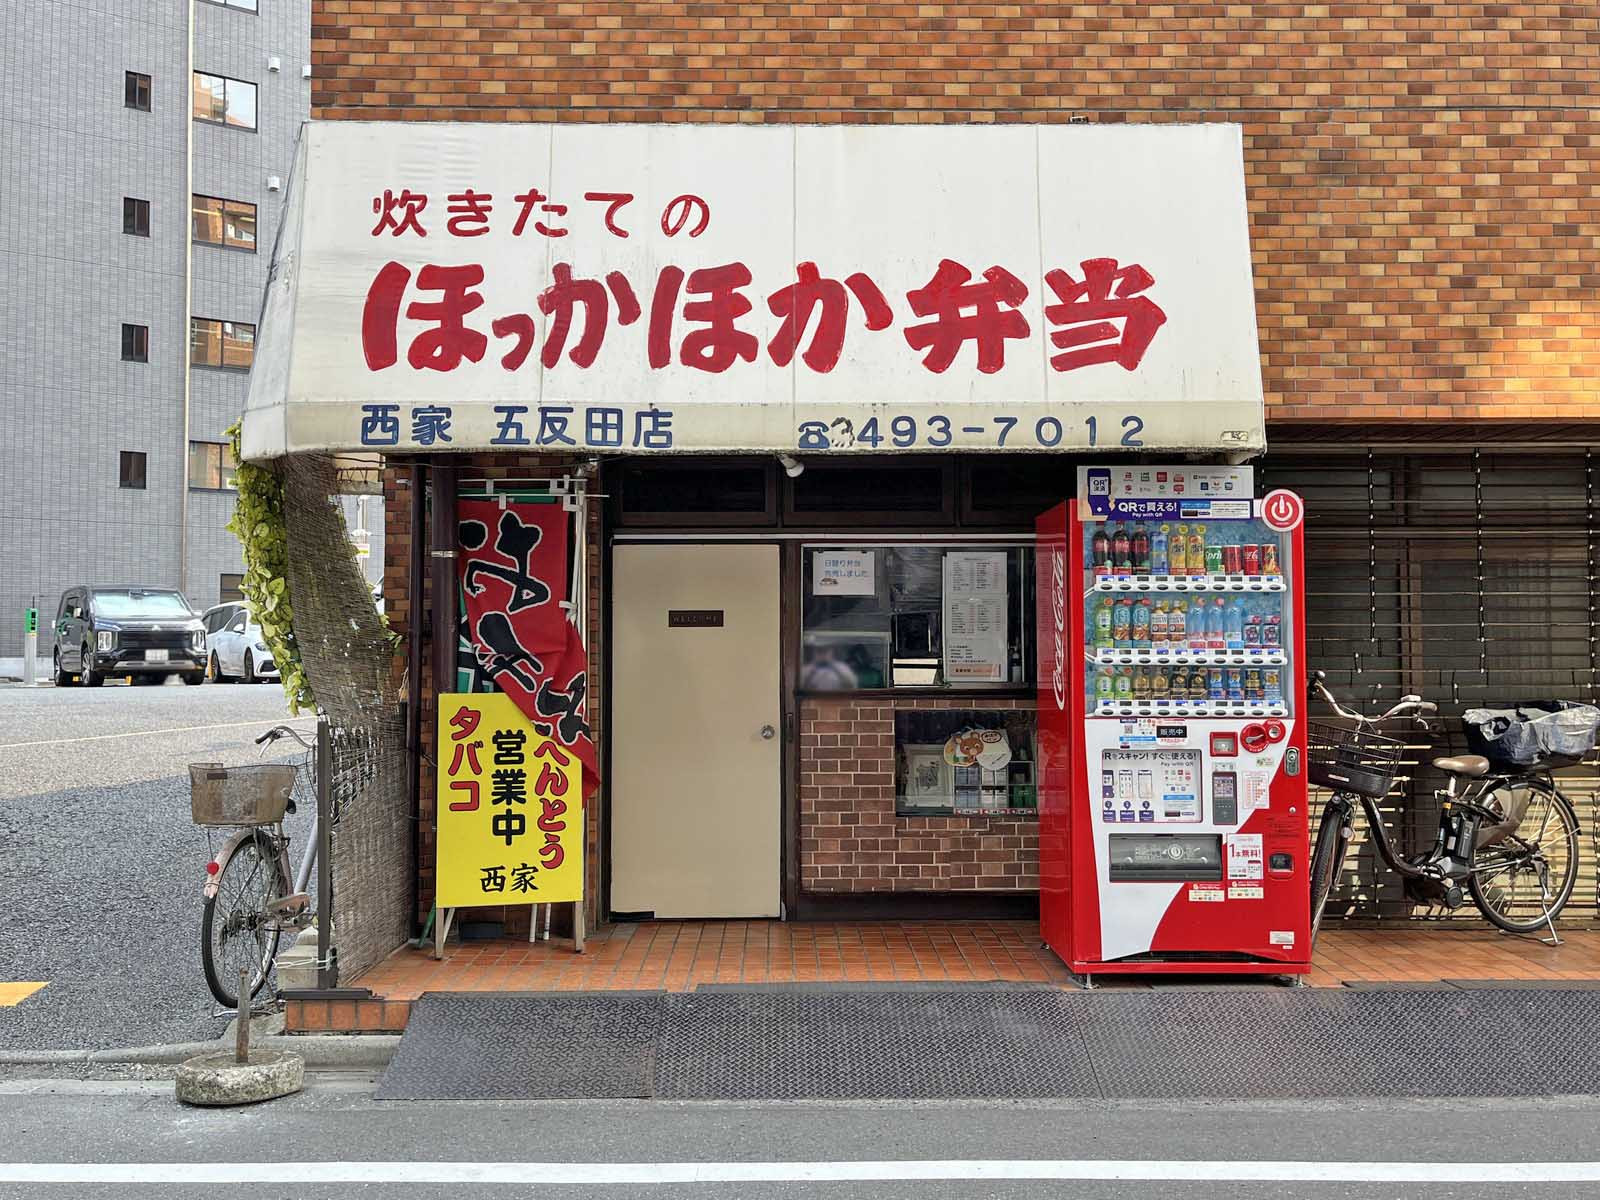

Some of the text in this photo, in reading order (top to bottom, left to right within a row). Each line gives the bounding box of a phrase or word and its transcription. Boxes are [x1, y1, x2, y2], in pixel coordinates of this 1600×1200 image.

[371, 187, 710, 238] 炊きたての
[361, 258, 1167, 373] ほっかほか弁当
[361, 403, 673, 448] 西家 五反田店
[448, 706, 484, 812] タバコ
[491, 729, 527, 846] 営業中
[479, 863, 539, 894] 西家
